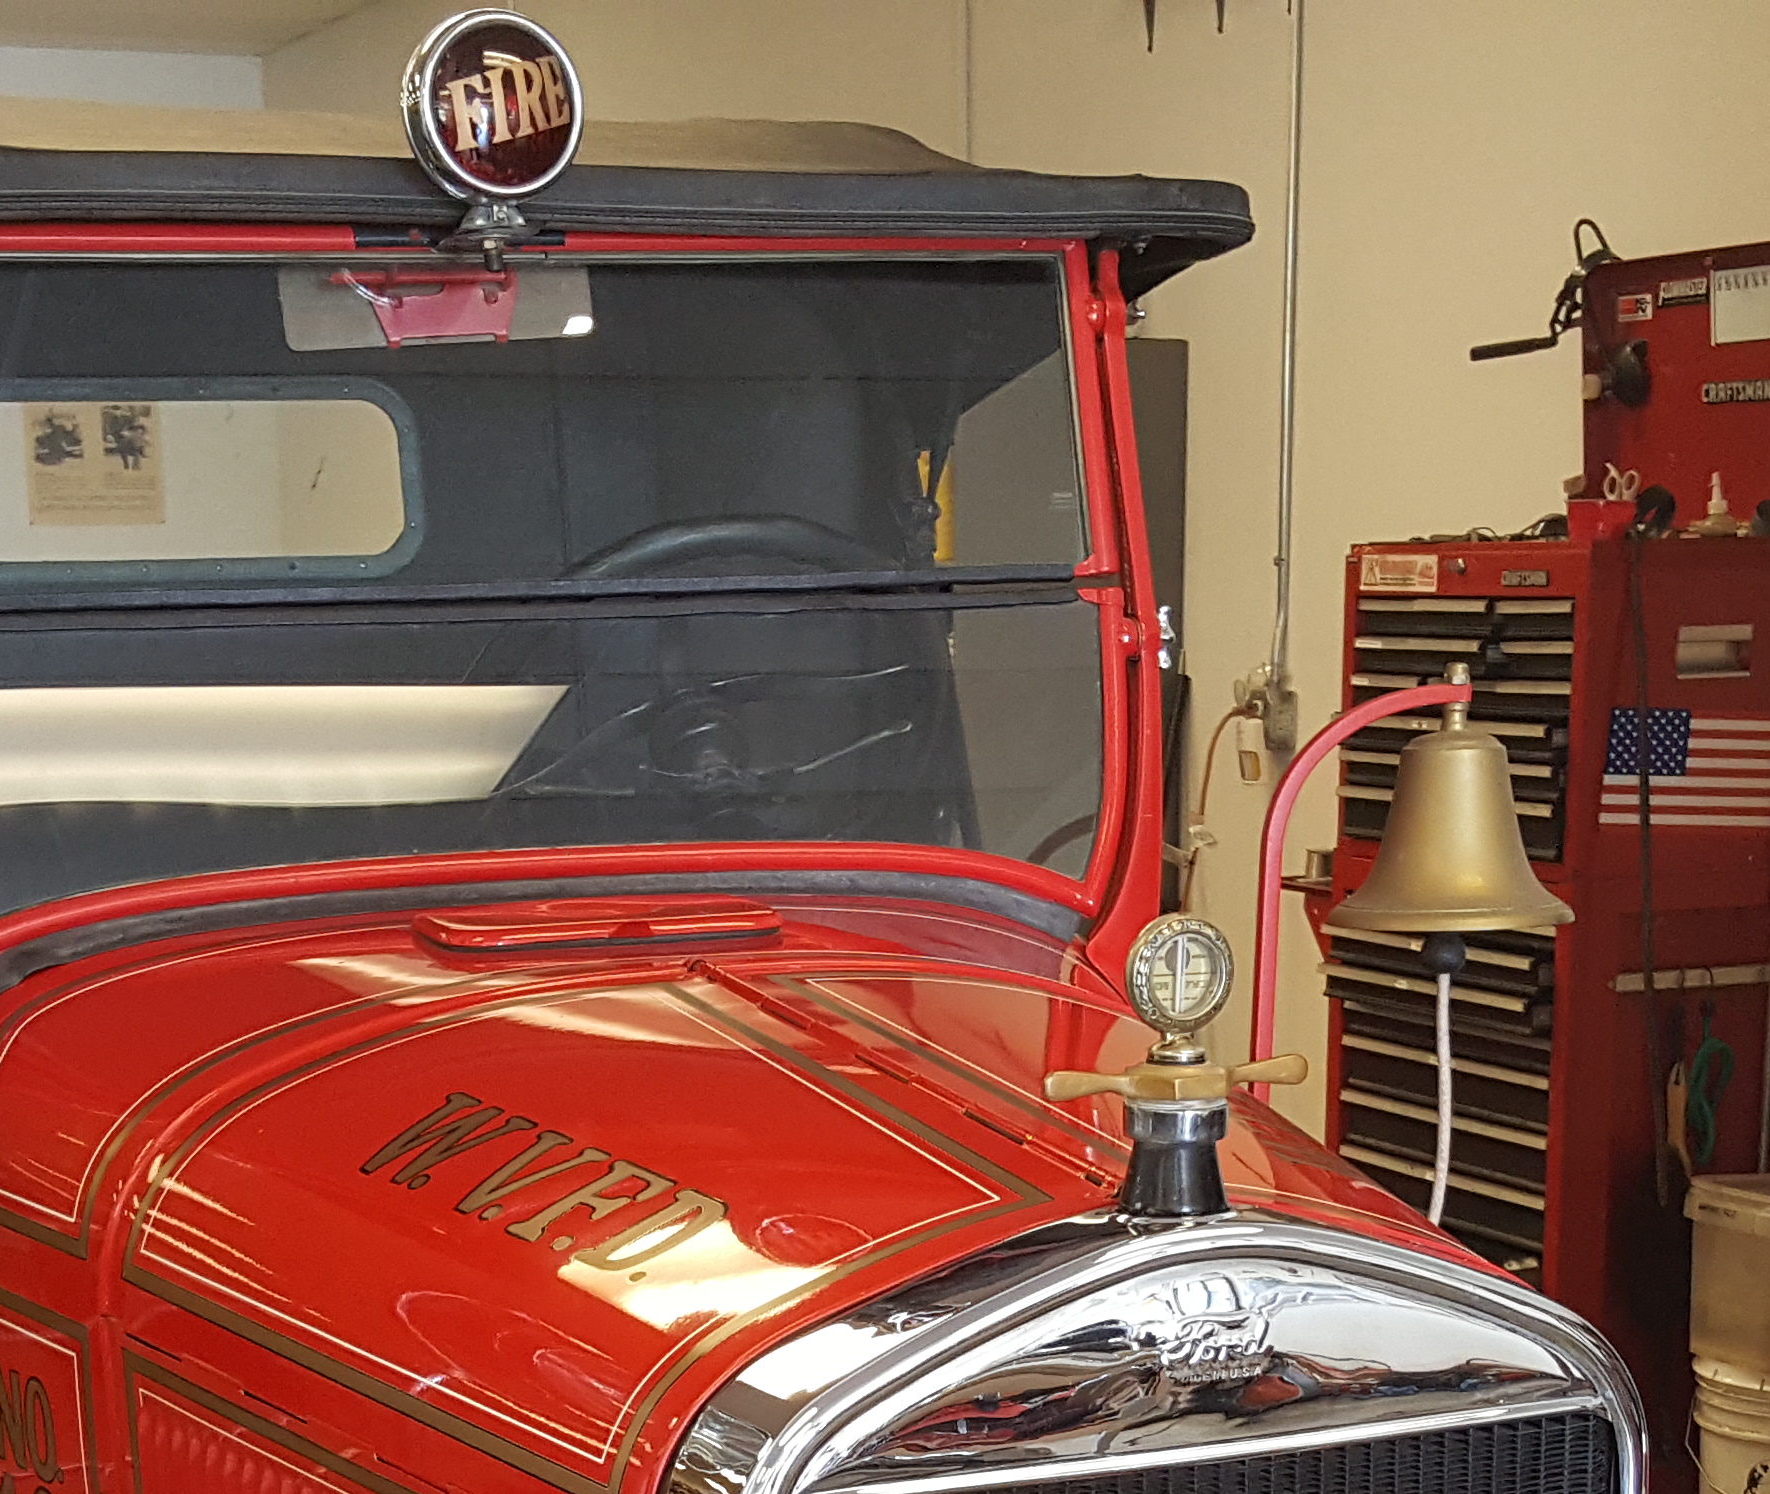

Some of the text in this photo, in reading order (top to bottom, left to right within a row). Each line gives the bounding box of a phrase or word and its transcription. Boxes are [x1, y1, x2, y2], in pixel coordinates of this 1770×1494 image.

[444, 54, 571, 152] FIRE
[358, 1091, 730, 1283] W.V.F.D.
[1160, 1319, 1273, 1366] Ford
